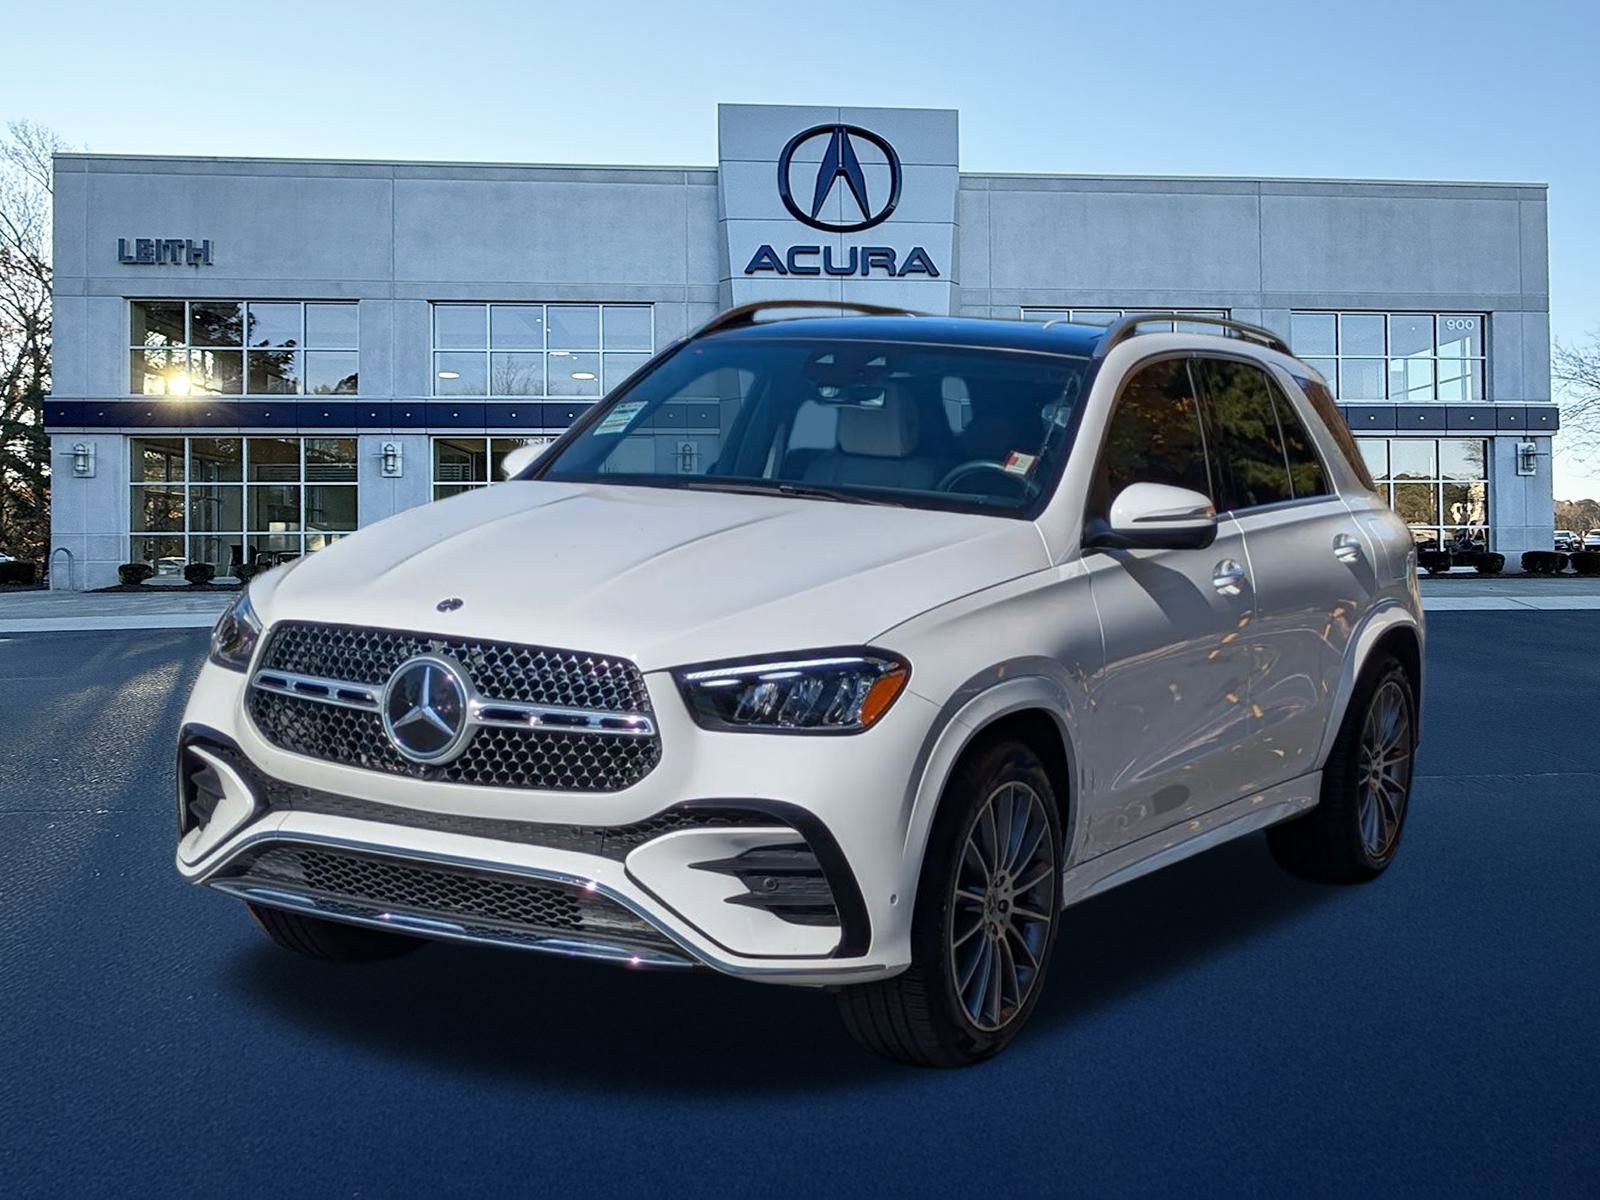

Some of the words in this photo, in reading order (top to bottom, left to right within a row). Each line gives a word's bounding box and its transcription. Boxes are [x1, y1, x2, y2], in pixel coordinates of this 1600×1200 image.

[118, 238, 212, 265] LEITH
[744, 245, 940, 277] ACURA
[1446, 319, 1474, 330] 900
